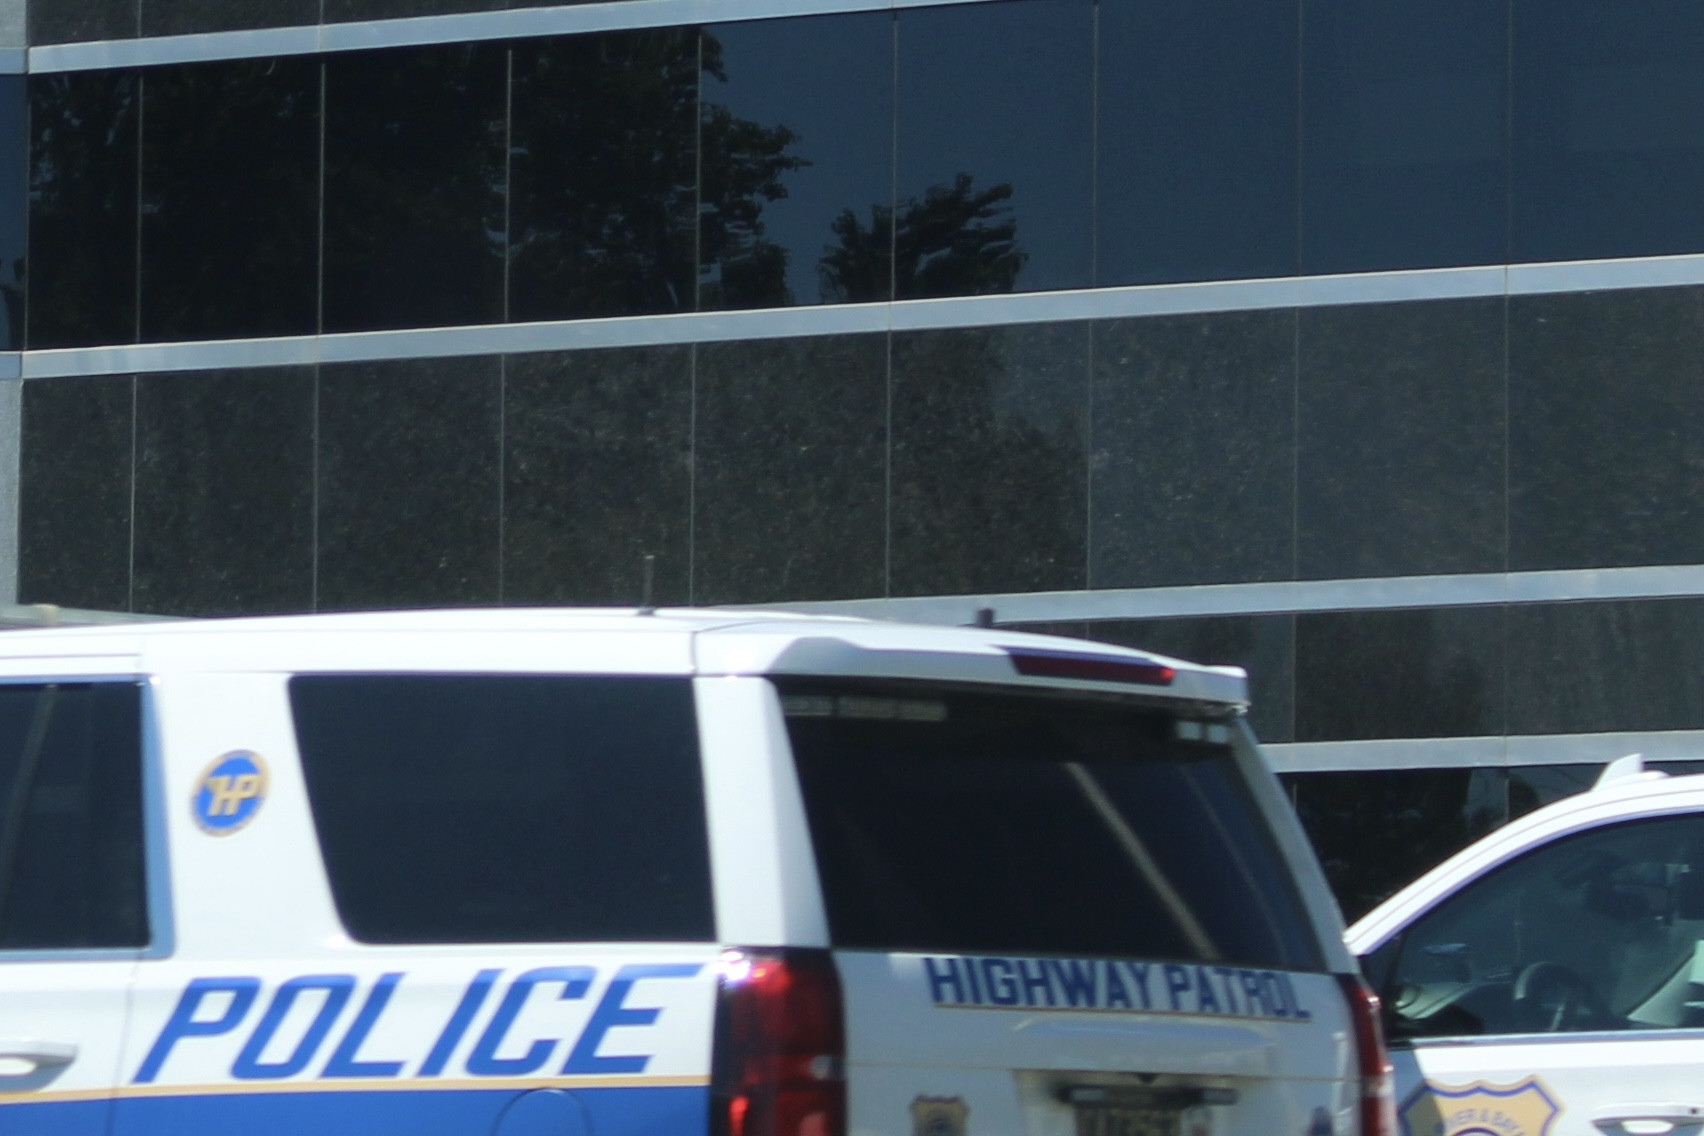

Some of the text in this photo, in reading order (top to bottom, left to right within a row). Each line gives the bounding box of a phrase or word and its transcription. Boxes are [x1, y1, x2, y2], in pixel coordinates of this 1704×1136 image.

[132, 963, 706, 1083] POLICE
[924, 957, 1312, 1019] HIGHWAY PATROL
